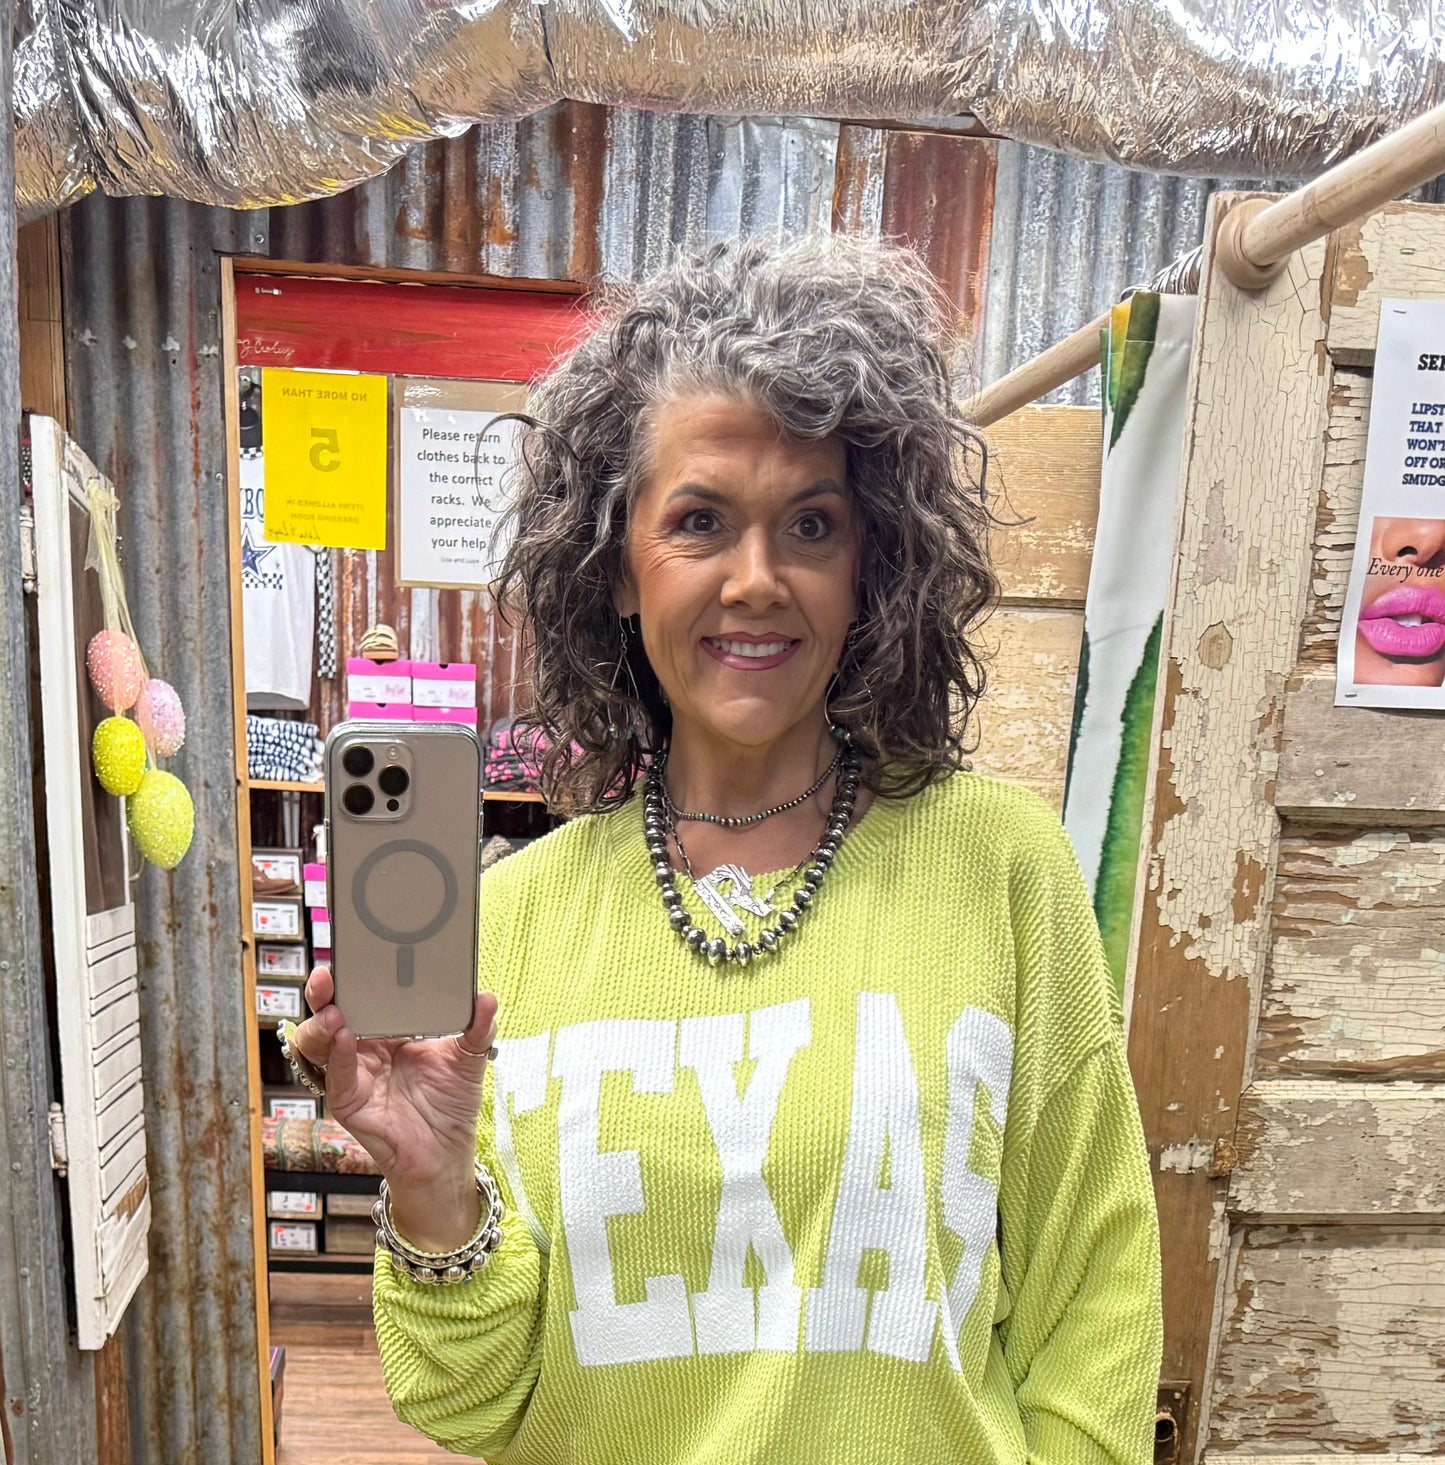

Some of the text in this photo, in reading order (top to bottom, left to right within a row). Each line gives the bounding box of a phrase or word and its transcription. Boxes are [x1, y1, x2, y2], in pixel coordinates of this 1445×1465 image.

[1409, 421, 1443, 433] THAT
[422, 428, 501, 443] Please return
[417, 450, 506, 465] clothes back to
[1404, 456, 1428, 468] OFF
[429, 472, 494, 486] the correct
[431, 494, 491, 507] racks. We
[429, 515, 492, 528] appreciate
[431, 537, 487, 551] your help
[1366, 557, 1444, 583] Every one
